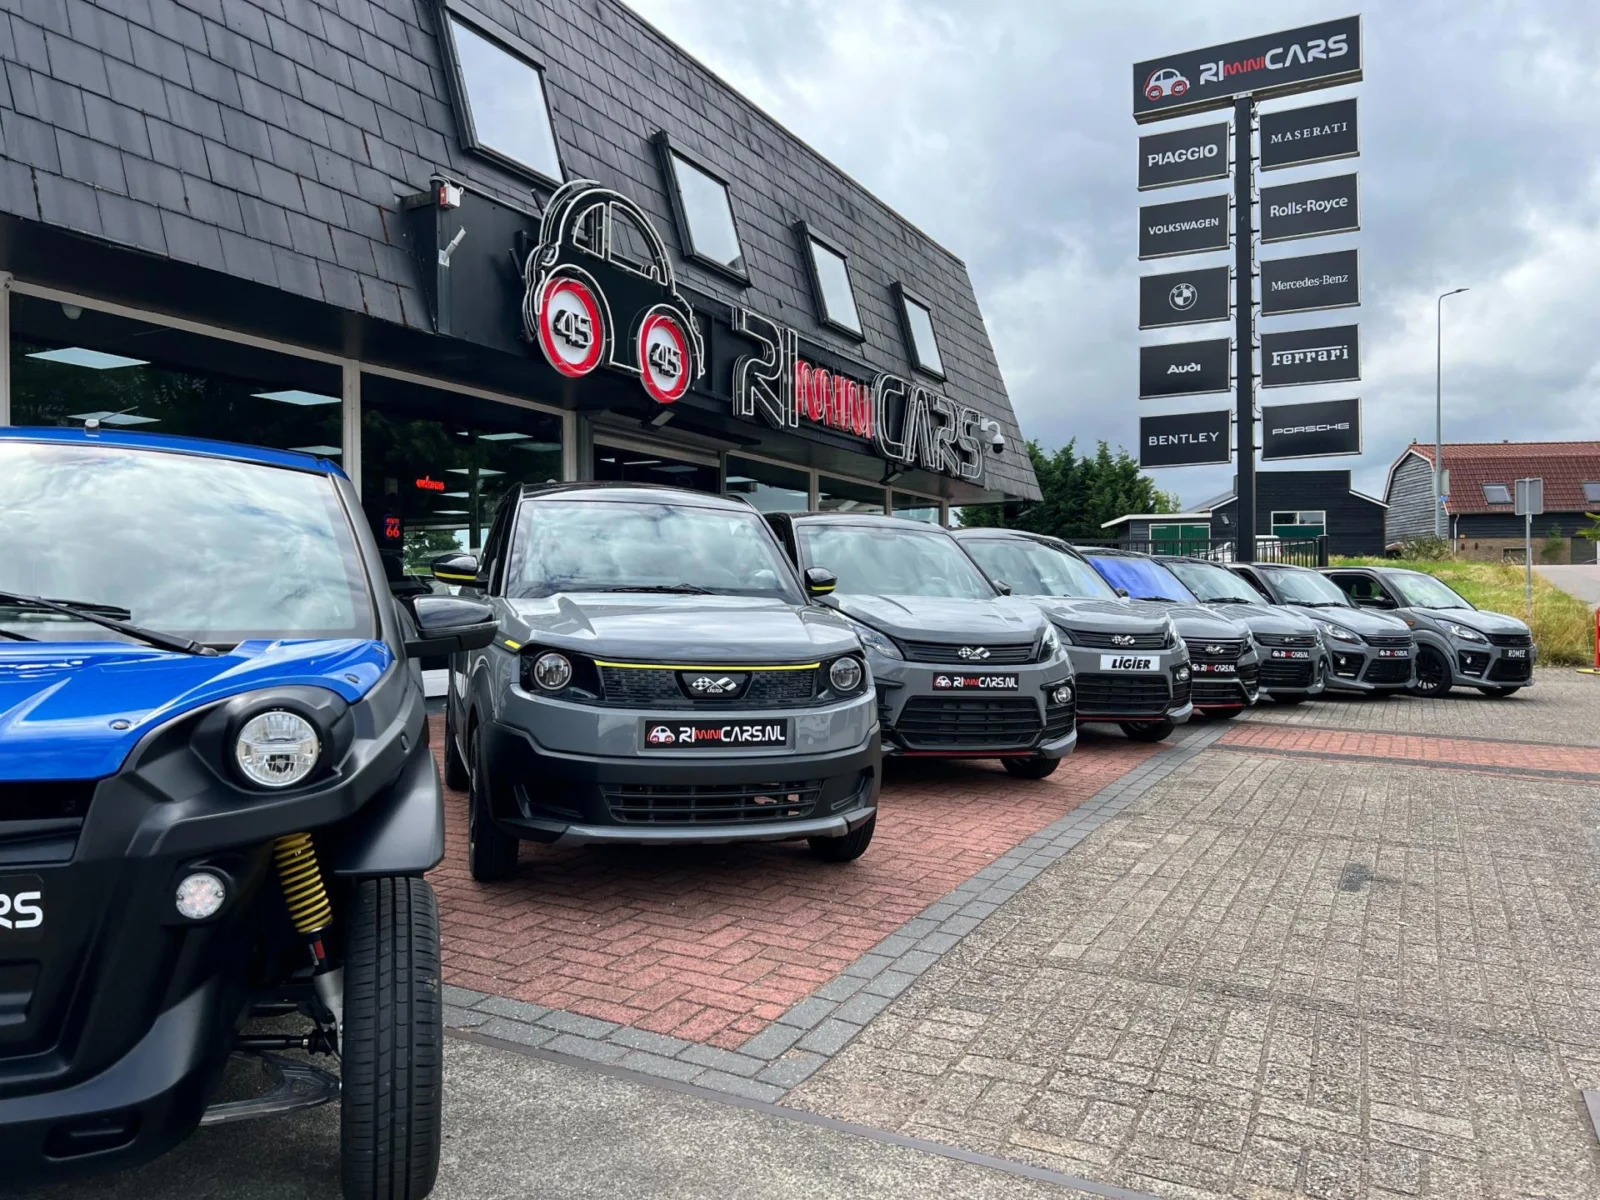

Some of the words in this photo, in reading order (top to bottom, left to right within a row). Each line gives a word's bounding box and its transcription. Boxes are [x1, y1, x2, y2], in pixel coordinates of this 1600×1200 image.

[1270, 122, 1348, 144] MASERATI
[1147, 144, 1218, 167] PIAGGIO
[1269, 197, 1348, 218] Rolls-Royce
[1148, 217, 1219, 235] VOLKSWAGEN
[1271, 275, 1348, 291] Mercedes-Benz
[553, 309, 594, 349] 45
[650, 343, 683, 378] 45
[1271, 345, 1349, 366] Ferrari
[1167, 363, 1201, 374] Audi
[1272, 423, 1350, 435] PORSCHE
[1148, 432, 1220, 446] BENTLEY
[386, 525, 400, 537] 66
